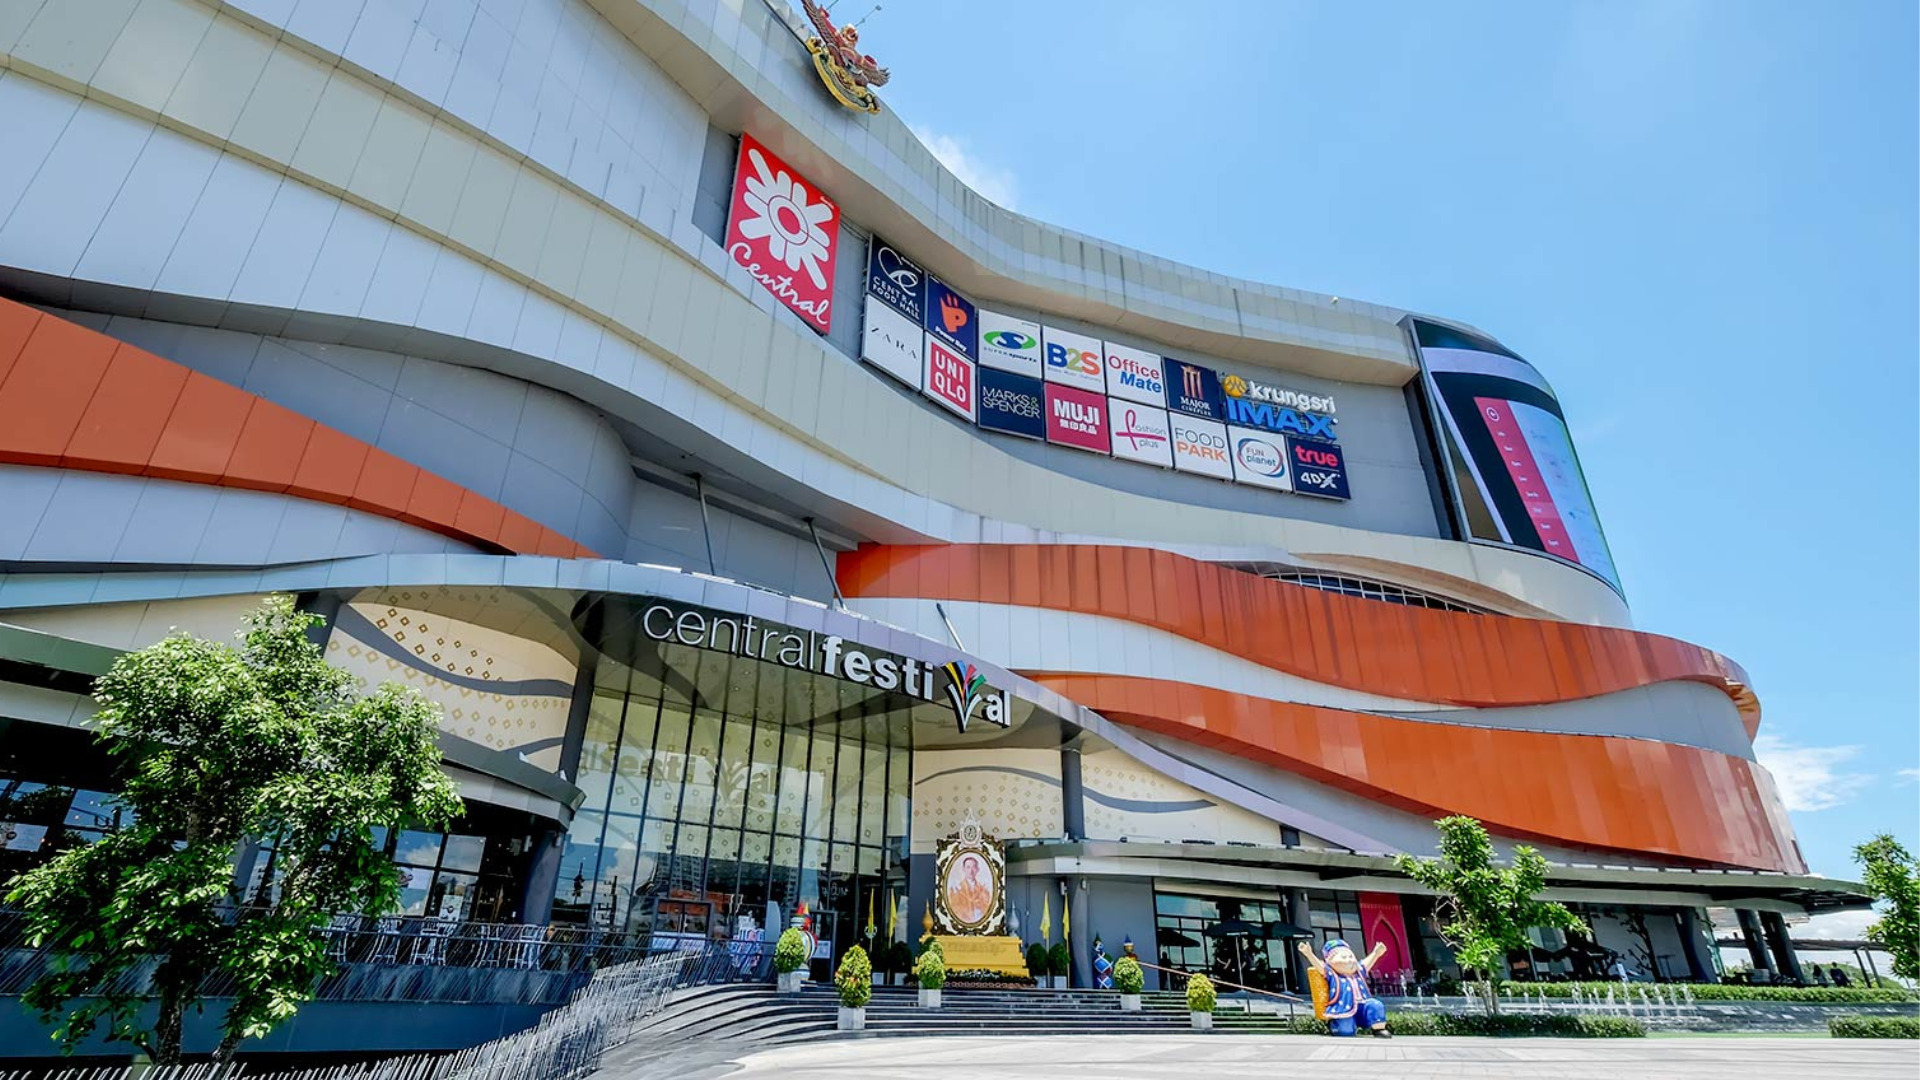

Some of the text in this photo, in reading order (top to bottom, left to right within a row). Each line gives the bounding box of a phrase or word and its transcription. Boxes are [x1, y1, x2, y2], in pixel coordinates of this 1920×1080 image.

[728, 242, 829, 325] Central
[873, 276, 920, 312] CENTRAL
[872, 284, 920, 320] FOOD HALL
[935, 350, 964, 383] UNI
[1047, 341, 1101, 375] B2S
[1108, 355, 1160, 379] Office
[934, 371, 966, 402] QLO
[1119, 371, 1162, 393] Mate
[983, 385, 1030, 406] MARKS
[983, 396, 1040, 419] SPENCER
[1179, 396, 1212, 411] MAJOR
[1249, 380, 1336, 413] krungsri
[1053, 398, 1100, 426] MUJI
[1226, 396, 1337, 440] IMAX
[1174, 427, 1225, 449] FOOD
[1176, 441, 1227, 463] PARK
[1294, 445, 1339, 467] true
[1300, 471, 1337, 489] 4DX
